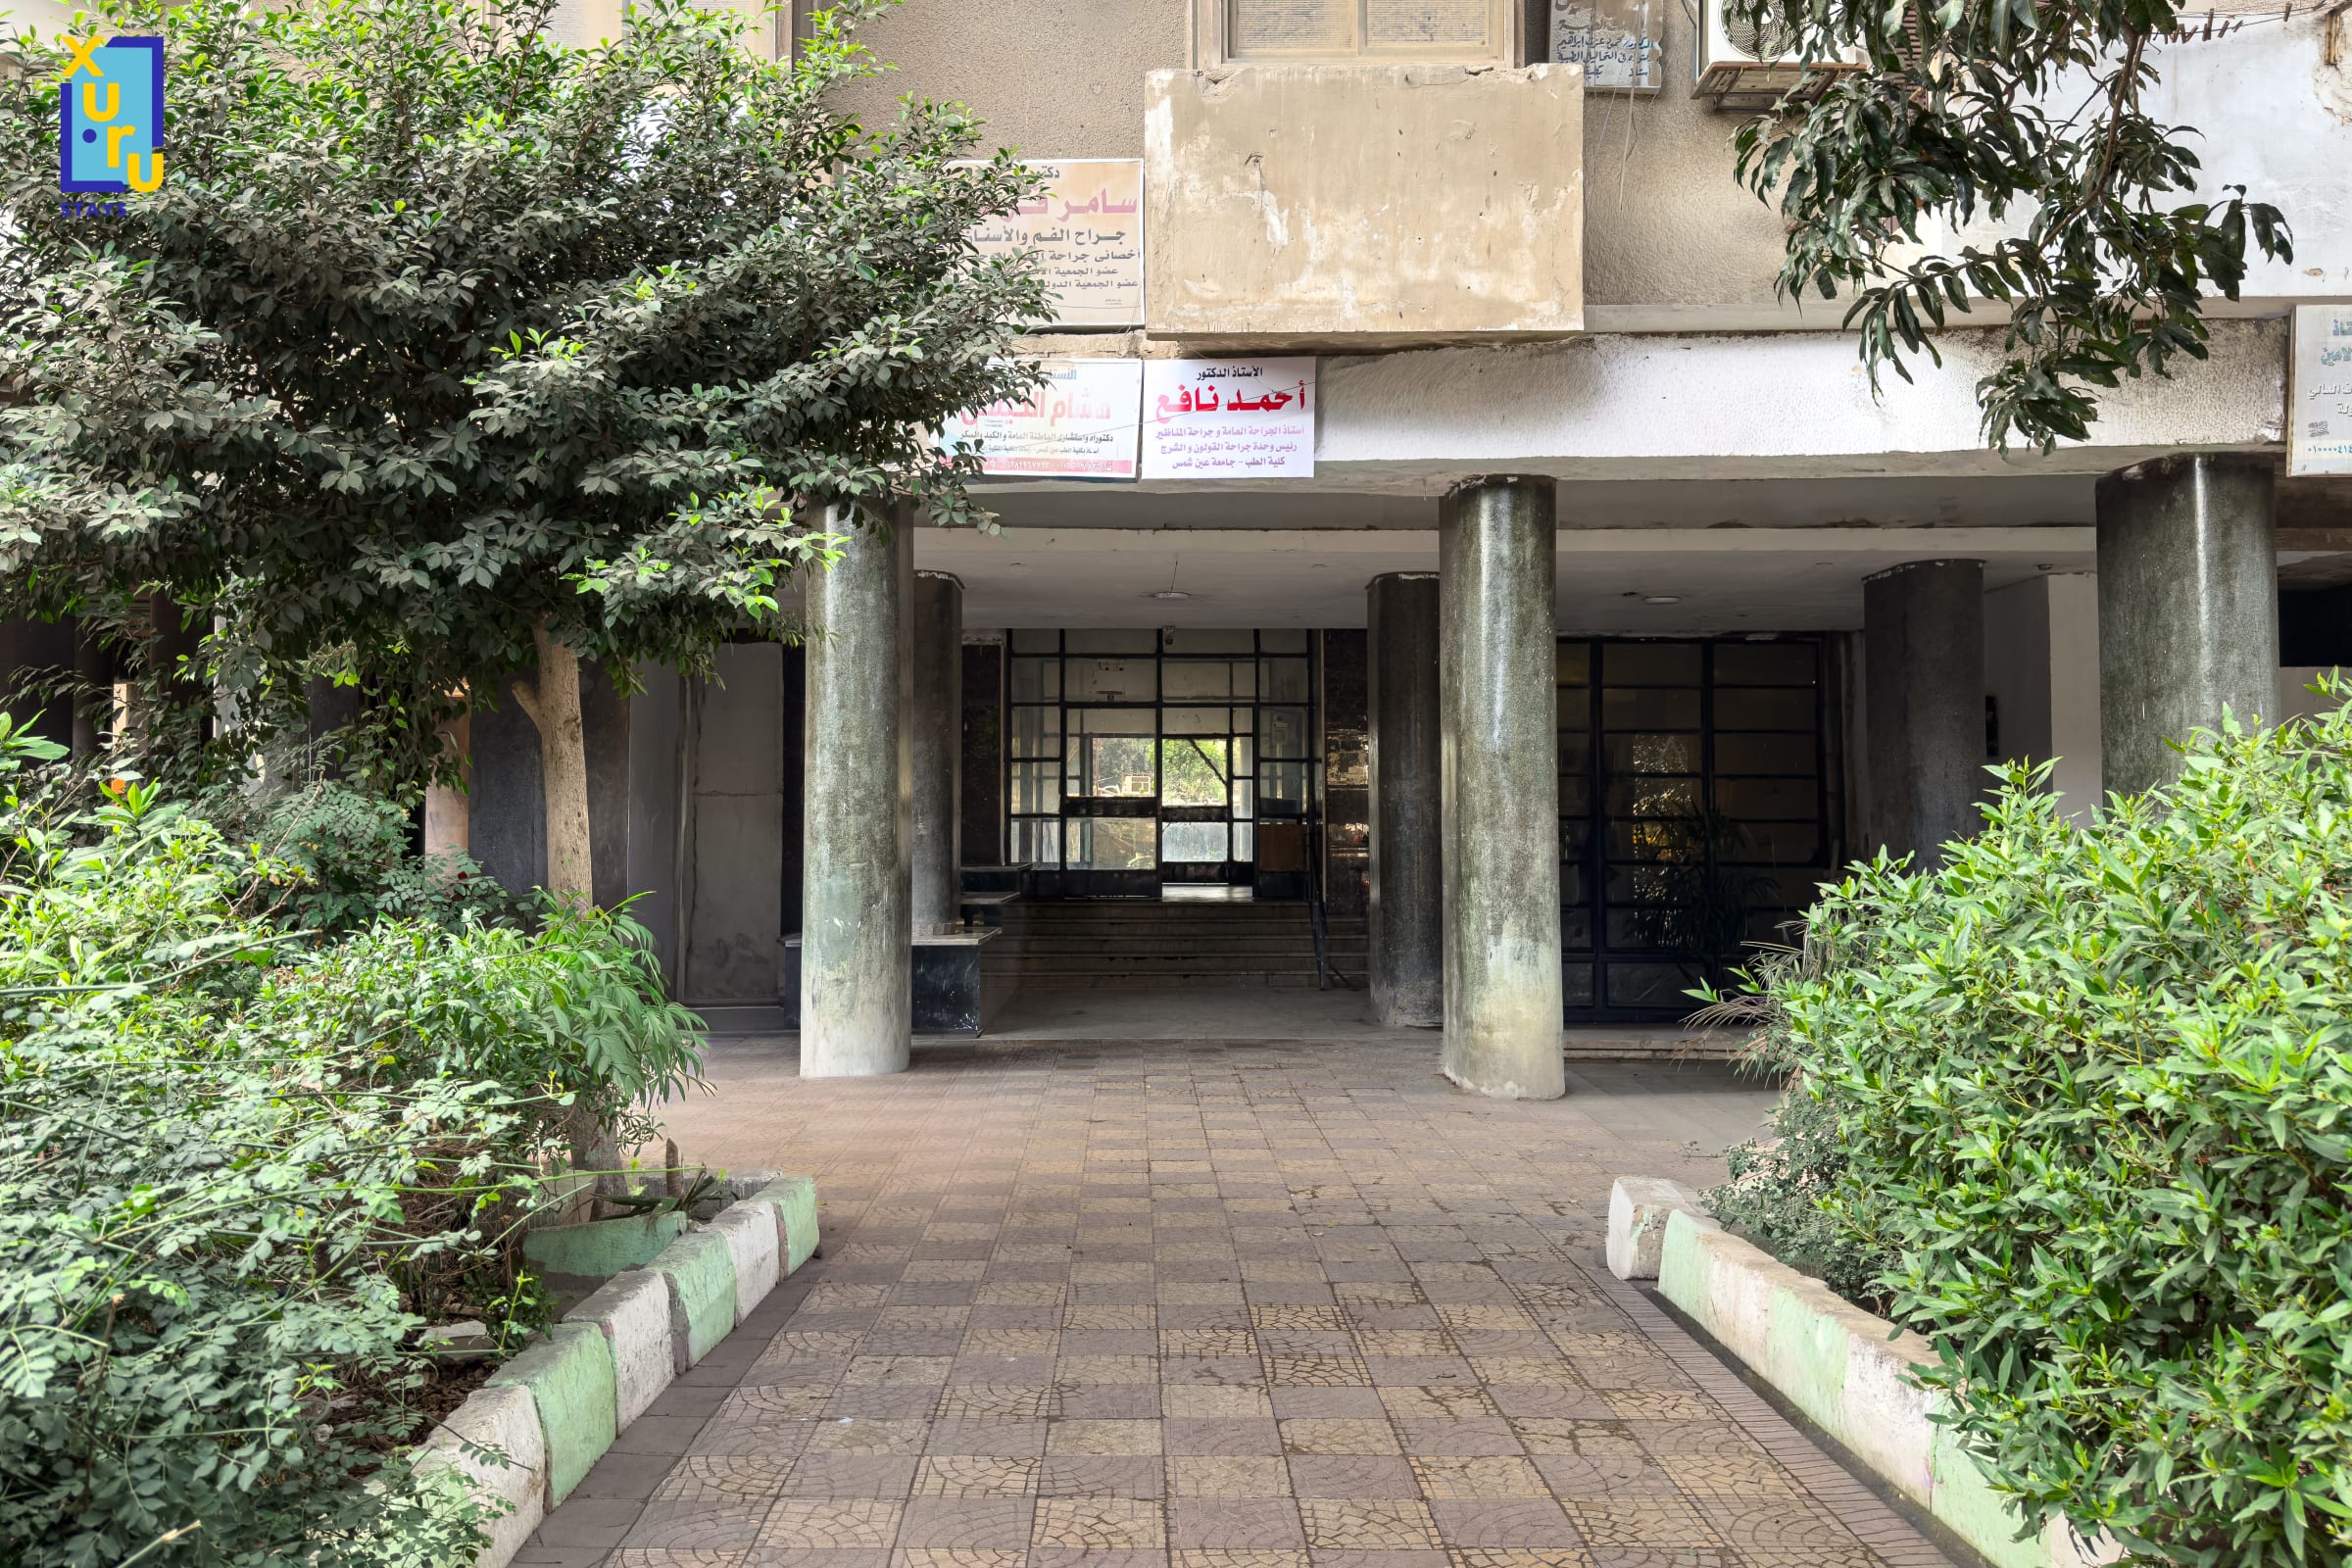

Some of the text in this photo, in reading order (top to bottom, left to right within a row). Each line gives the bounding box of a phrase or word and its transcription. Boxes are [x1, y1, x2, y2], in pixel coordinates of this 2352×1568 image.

[1055, 187, 1138, 222] سامر
[1032, 226, 1070, 246] الفم
[1074, 227, 1126, 246] جراح
[1049, 250, 1090, 263] جراحة
[1054, 267, 1093, 277] الجمعية
[1096, 267, 1118, 277] عضو
[1074, 279, 1113, 290] الجمعية
[1116, 279, 1139, 289] عضو
[1196, 367, 1230, 380] الدكتور
[1050, 386, 1110, 426] هشام
[1155, 379, 1305, 424] أحمد نافع
[1154, 427, 1186, 440] المناظير
[1188, 426, 1214, 438] جراحة
[1222, 425, 1247, 436] العامة
[1248, 425, 1282, 438] الجراحة
[1160, 442, 1186, 455] الشرج
[1194, 443, 1224, 454] القولون
[1225, 441, 1251, 454] جراحة
[1252, 441, 1274, 453] وحدة
[1275, 442, 1298, 453] رئيس
[1172, 456, 1286, 469] كلية الطب جامعة عين شمس
